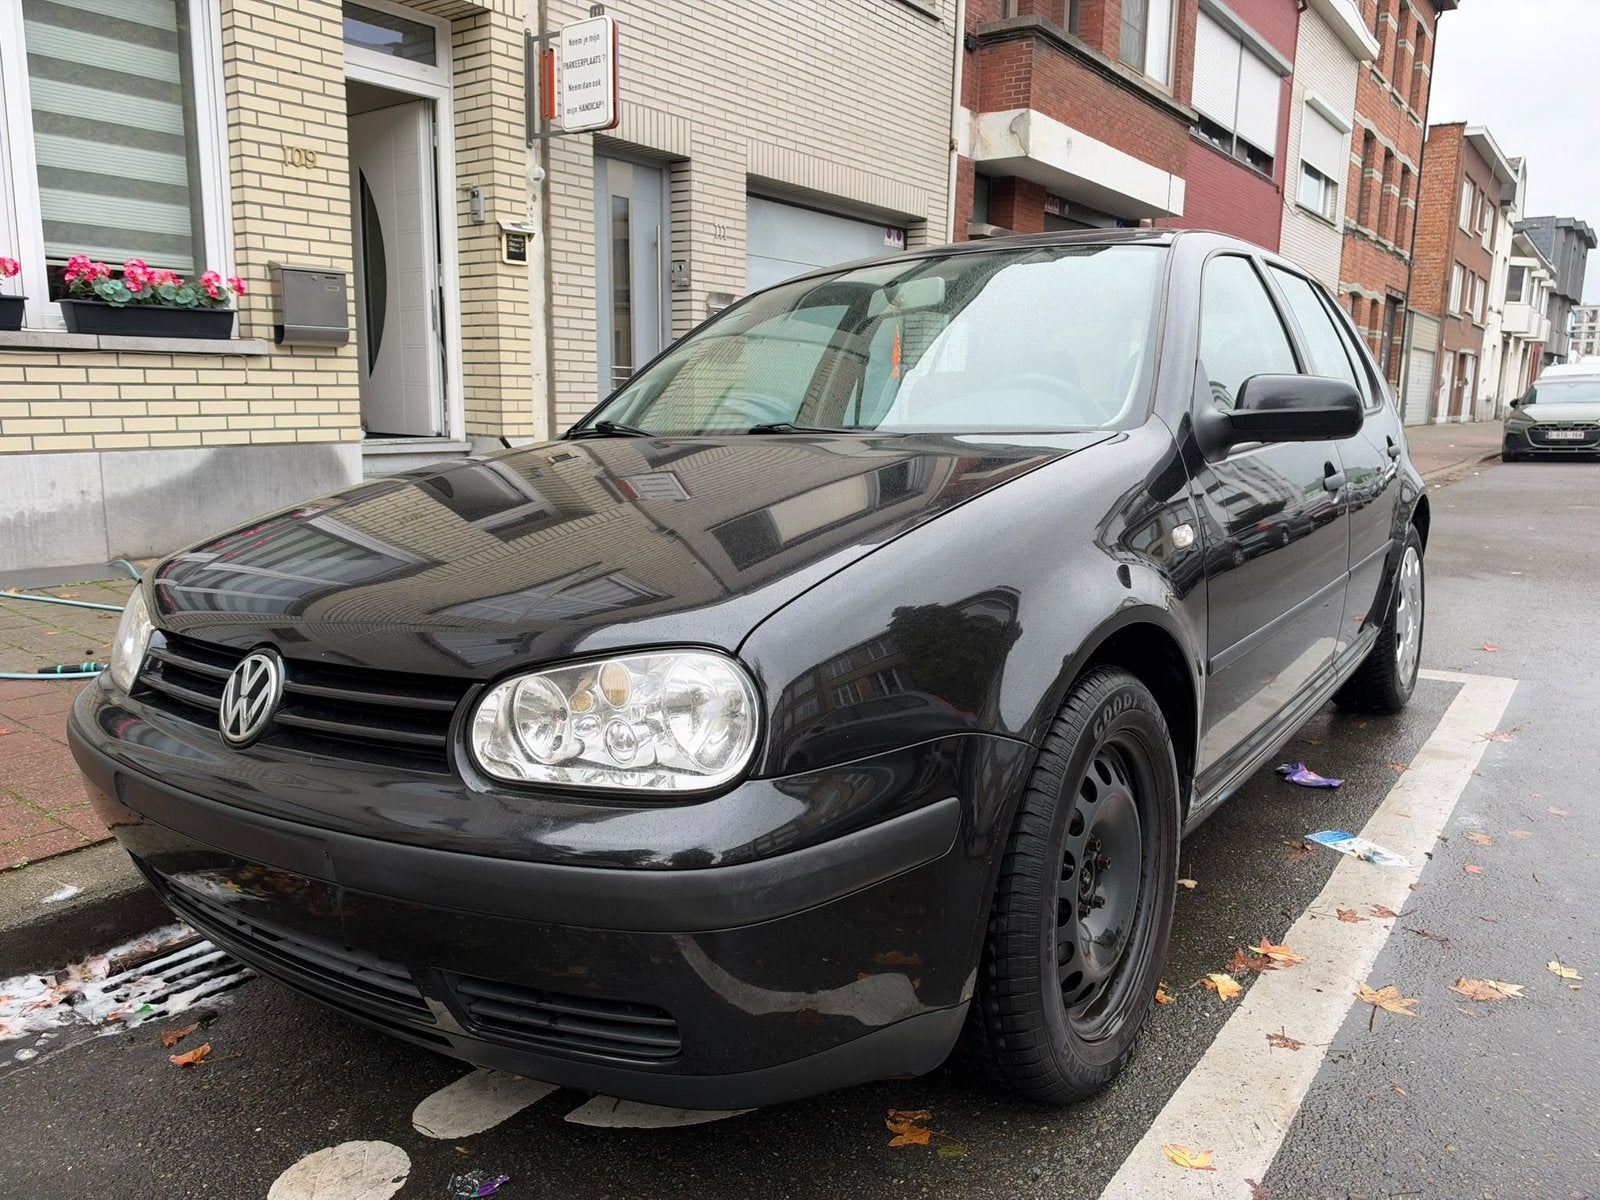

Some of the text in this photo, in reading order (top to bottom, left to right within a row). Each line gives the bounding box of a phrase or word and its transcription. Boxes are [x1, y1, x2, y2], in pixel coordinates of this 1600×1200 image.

[568, 33, 600, 47] Neem je mijn
[563, 55, 602, 70] PARKEERPLAATS
[568, 78, 602, 92] Neem dan ook
[566, 106, 578, 116] mijn
[281, 145, 317, 169] 109
[221, 654, 277, 742] VW
